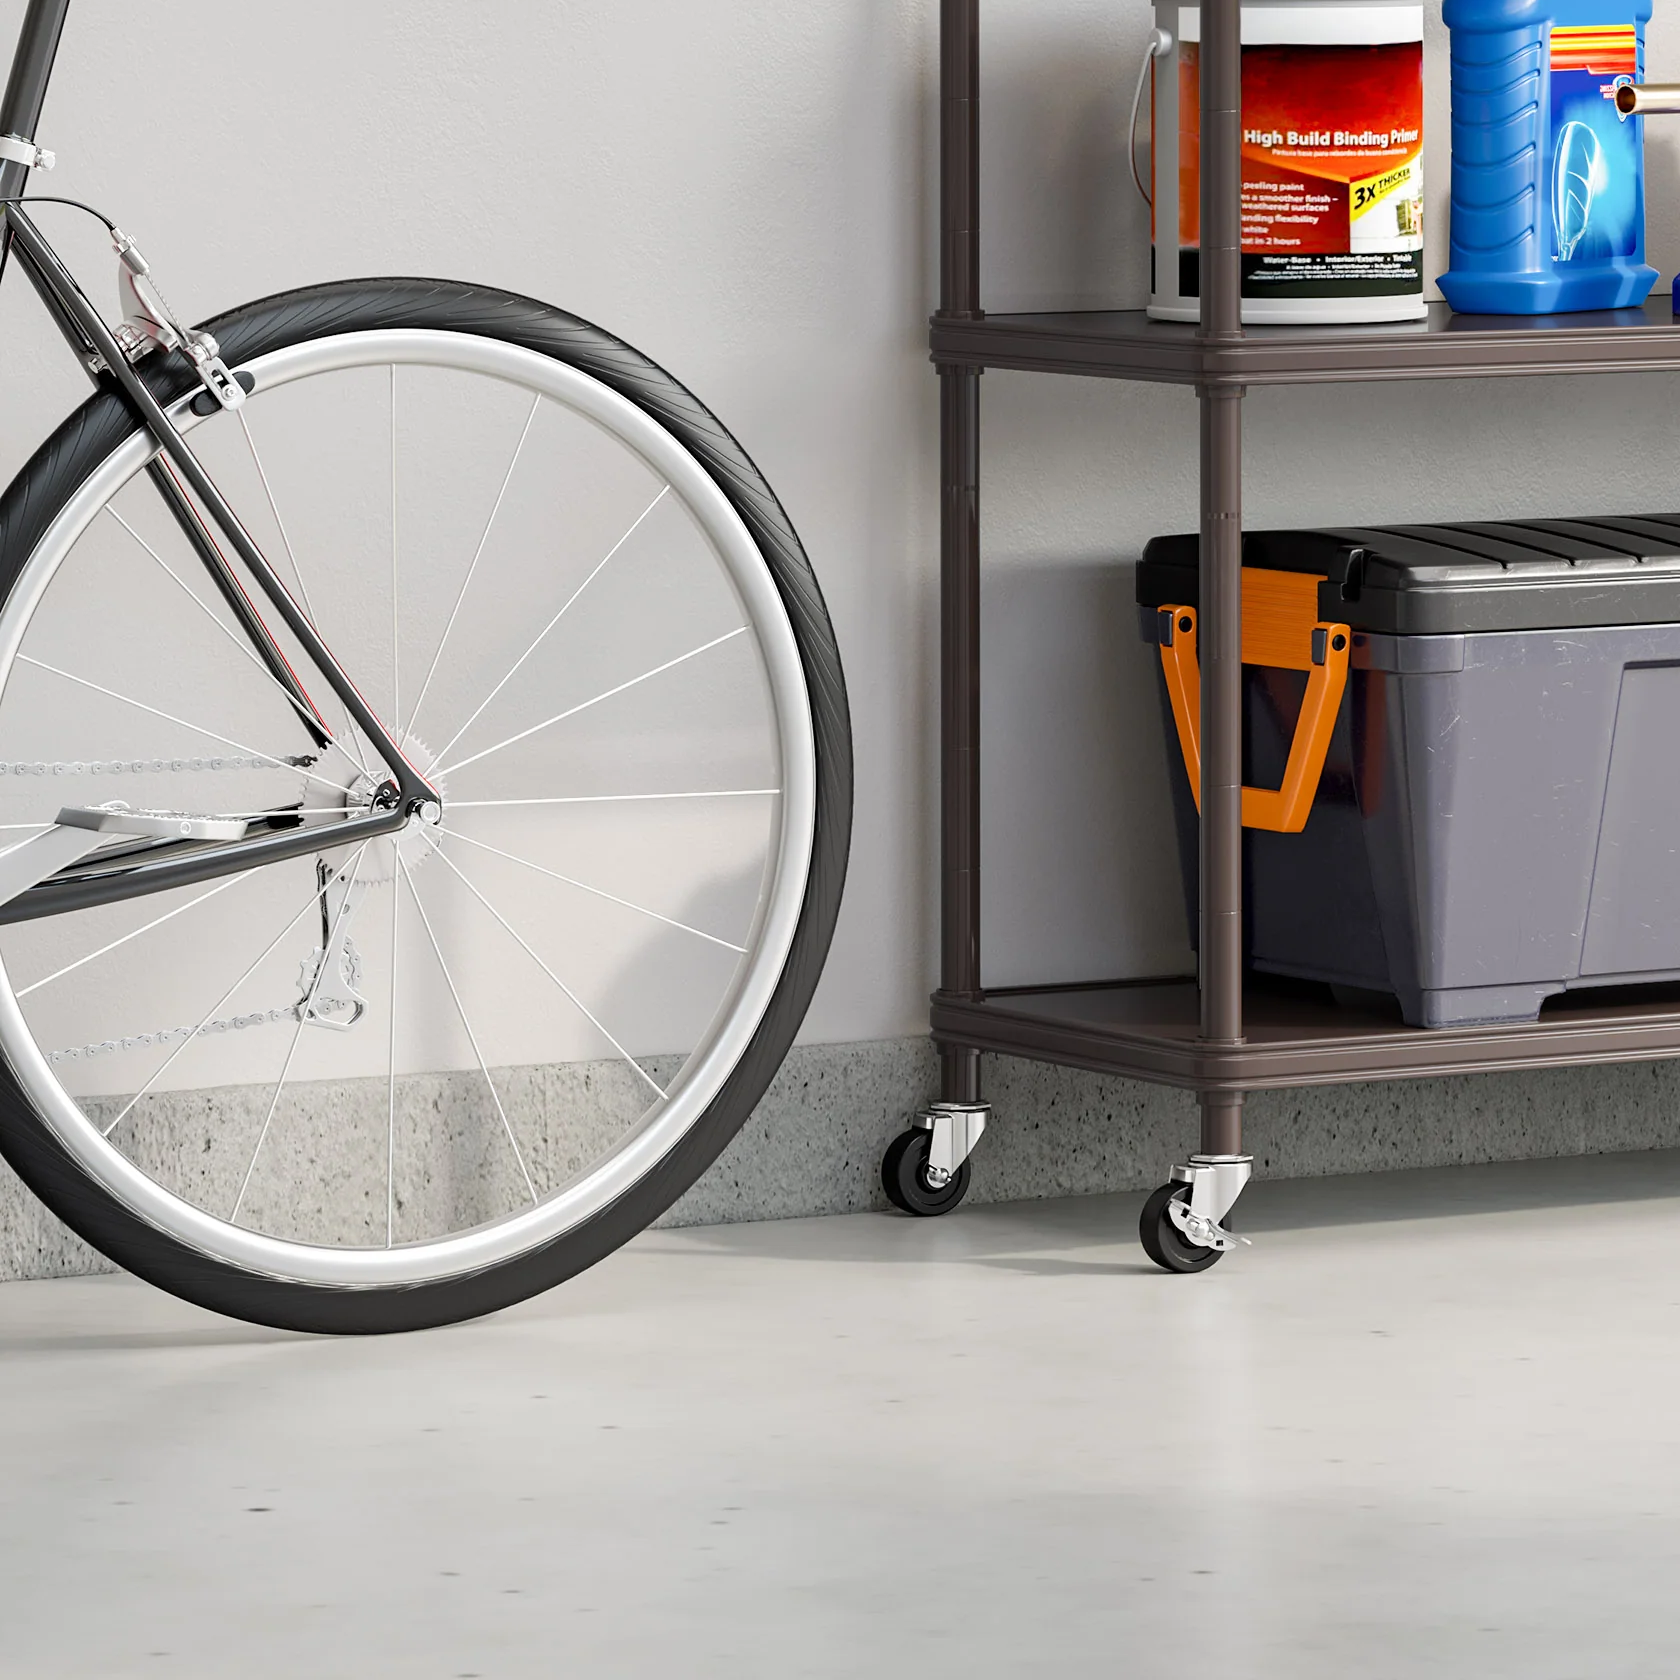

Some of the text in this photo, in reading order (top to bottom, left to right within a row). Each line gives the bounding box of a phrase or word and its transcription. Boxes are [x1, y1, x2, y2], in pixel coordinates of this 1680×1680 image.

[1243, 128, 1419, 148] High Build Binding Primer
[1378, 167, 1410, 189] THICKER
[1242, 182, 1305, 192] peeling paint
[1258, 194, 1304, 202] smoother
[1305, 194, 1331, 203] finish
[1290, 203, 1330, 211] surfaces
[1274, 214, 1319, 225] flexibility
[1265, 237, 1273, 245] 2
[1273, 237, 1301, 246] hours
